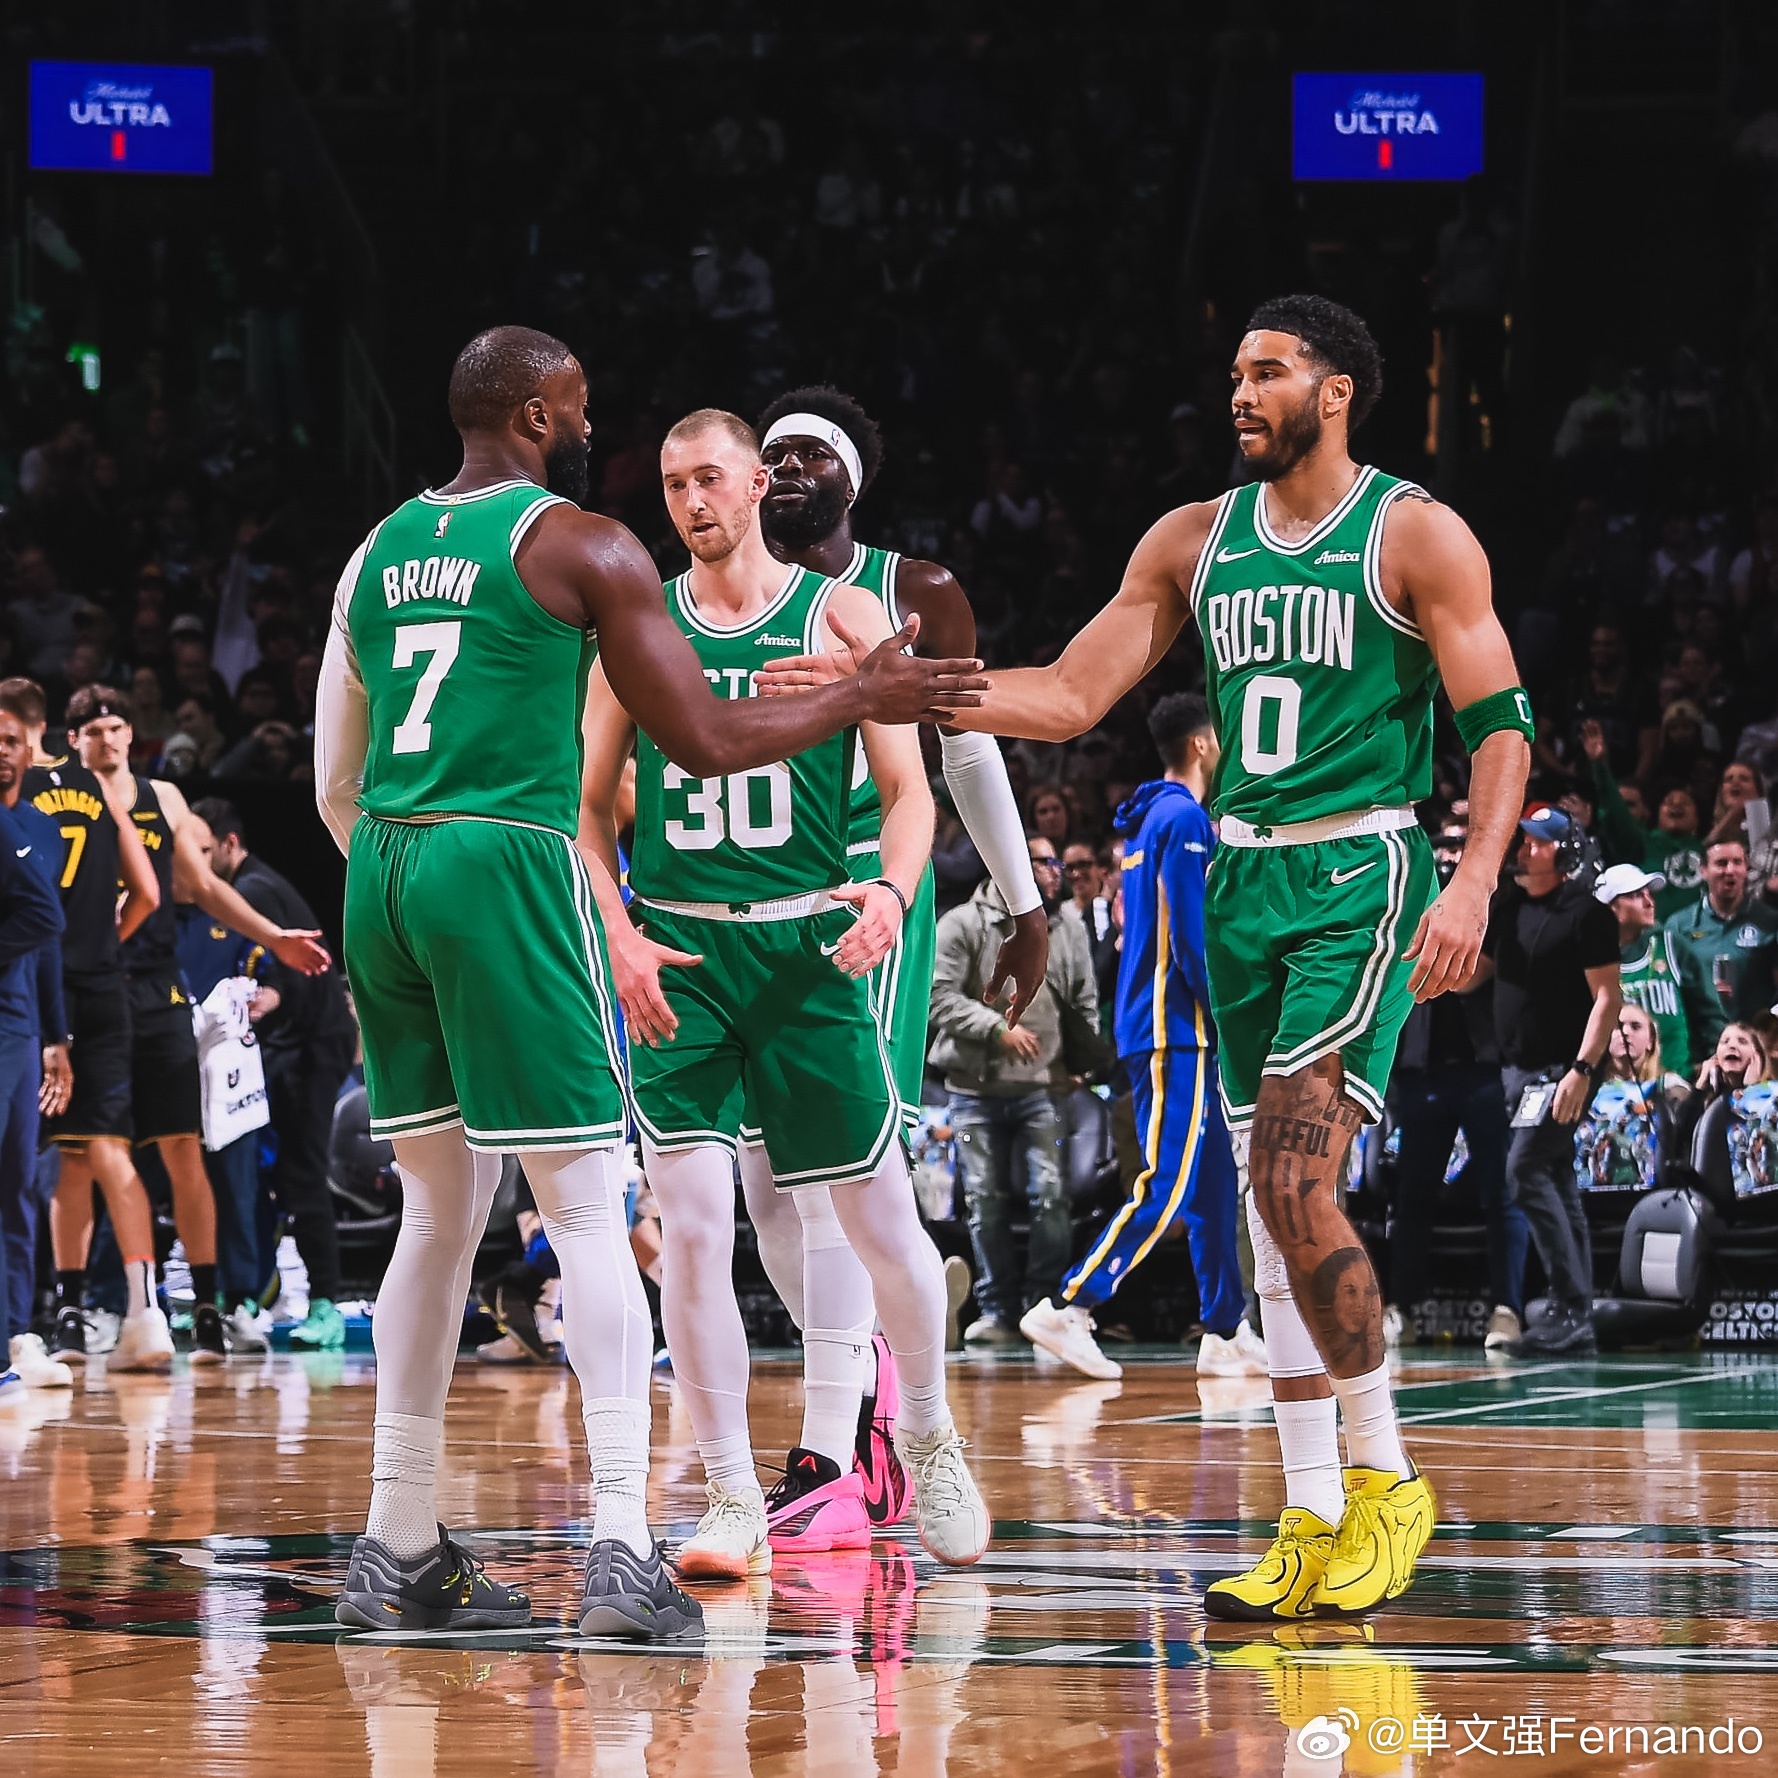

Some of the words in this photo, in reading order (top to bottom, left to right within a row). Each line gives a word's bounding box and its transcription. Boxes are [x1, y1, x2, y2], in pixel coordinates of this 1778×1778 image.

[69, 100, 171, 127] ULTRA
[1334, 110, 1440, 135] ULTRA
[382, 556, 482, 609] BROWN
[1313, 550, 1361, 565] Amica
[754, 632, 801, 648] Amica
[1208, 584, 1355, 672] BOSTON
[391, 620, 462, 755] 7
[1241, 674, 1302, 776] 0
[663, 760, 793, 850] 30
[59, 825, 87, 888] 7
[1709, 1301, 1778, 1321] OSTO
